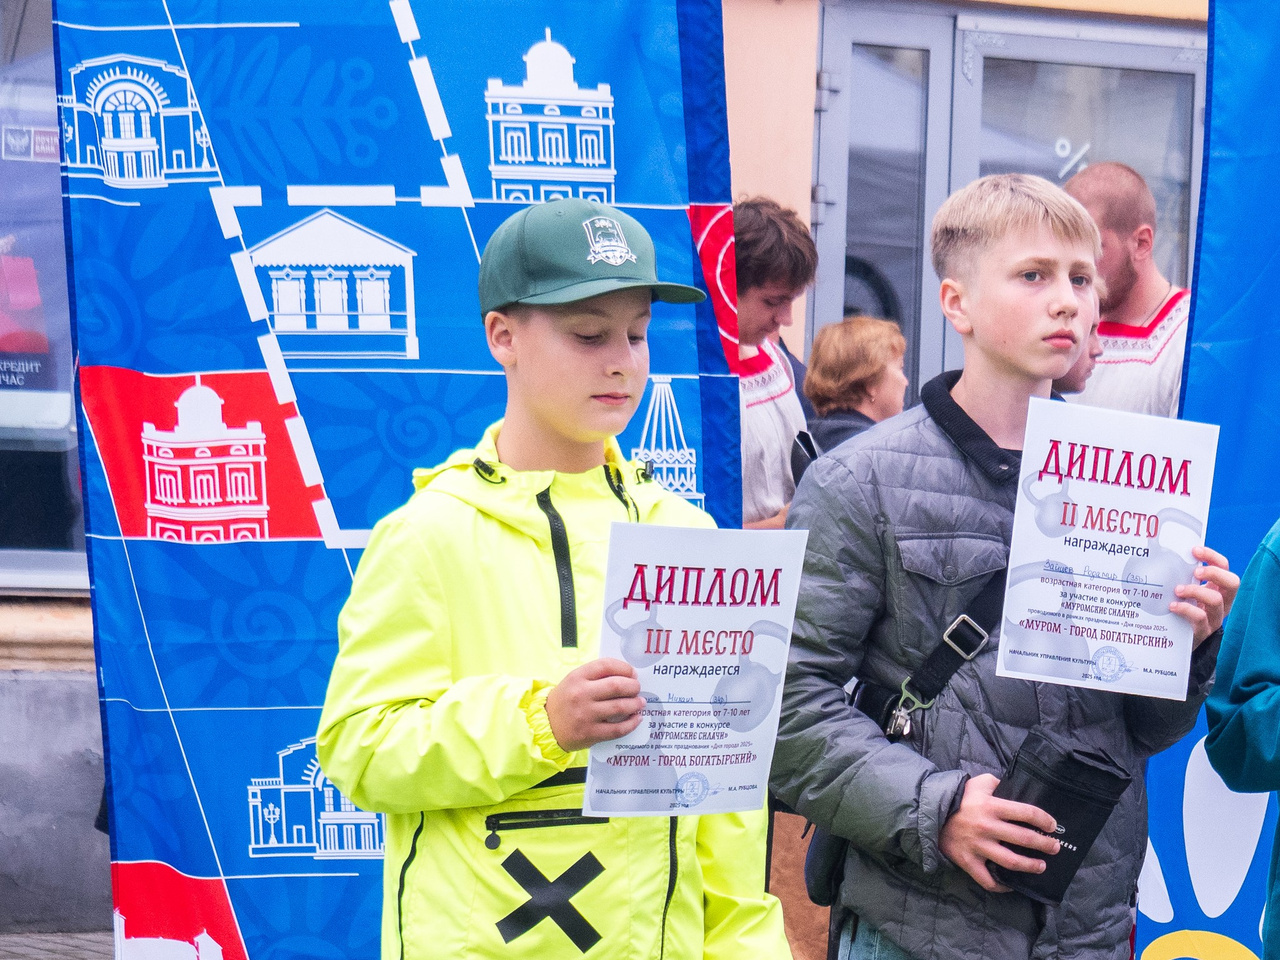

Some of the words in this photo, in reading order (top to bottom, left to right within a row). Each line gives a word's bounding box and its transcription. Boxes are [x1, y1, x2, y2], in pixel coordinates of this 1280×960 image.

[1038, 440, 1191, 497] ДИПЛОМ
[1082, 506, 1159, 538] МЕСТО
[1064, 536, 1150, 557] награждается
[623, 563, 782, 611] ДИПЛОМ
[1040, 576, 1081, 589] возрастная
[1083, 582, 1120, 595] категория
[1132, 588, 1148, 597] 7-10
[1068, 592, 1097, 603] участие
[1105, 597, 1141, 610] конкурсе
[677, 630, 754, 655] МЕСТО
[1018, 617, 1061, 634] «МУРОМ
[1069, 624, 1098, 640] ГОРОД
[1099, 627, 1174, 650] БОГАТЫРСКИЙ»
[1008, 648, 1038, 658] НАЧАЛЬНИК
[1039, 652, 1071, 662] УПРАВЛЕНИЯ
[1071, 657, 1096, 666] КУЛЬТУРЫ
[653, 664, 740, 680] награждается
[673, 709, 711, 718] категория
[722, 708, 737, 716] 7-10
[657, 721, 687, 729] участие
[605, 754, 650, 767] «МУРОМ
[657, 754, 688, 767] ГОРОД
[688, 751, 757, 766] БОГАТЫРСКИЙ»
